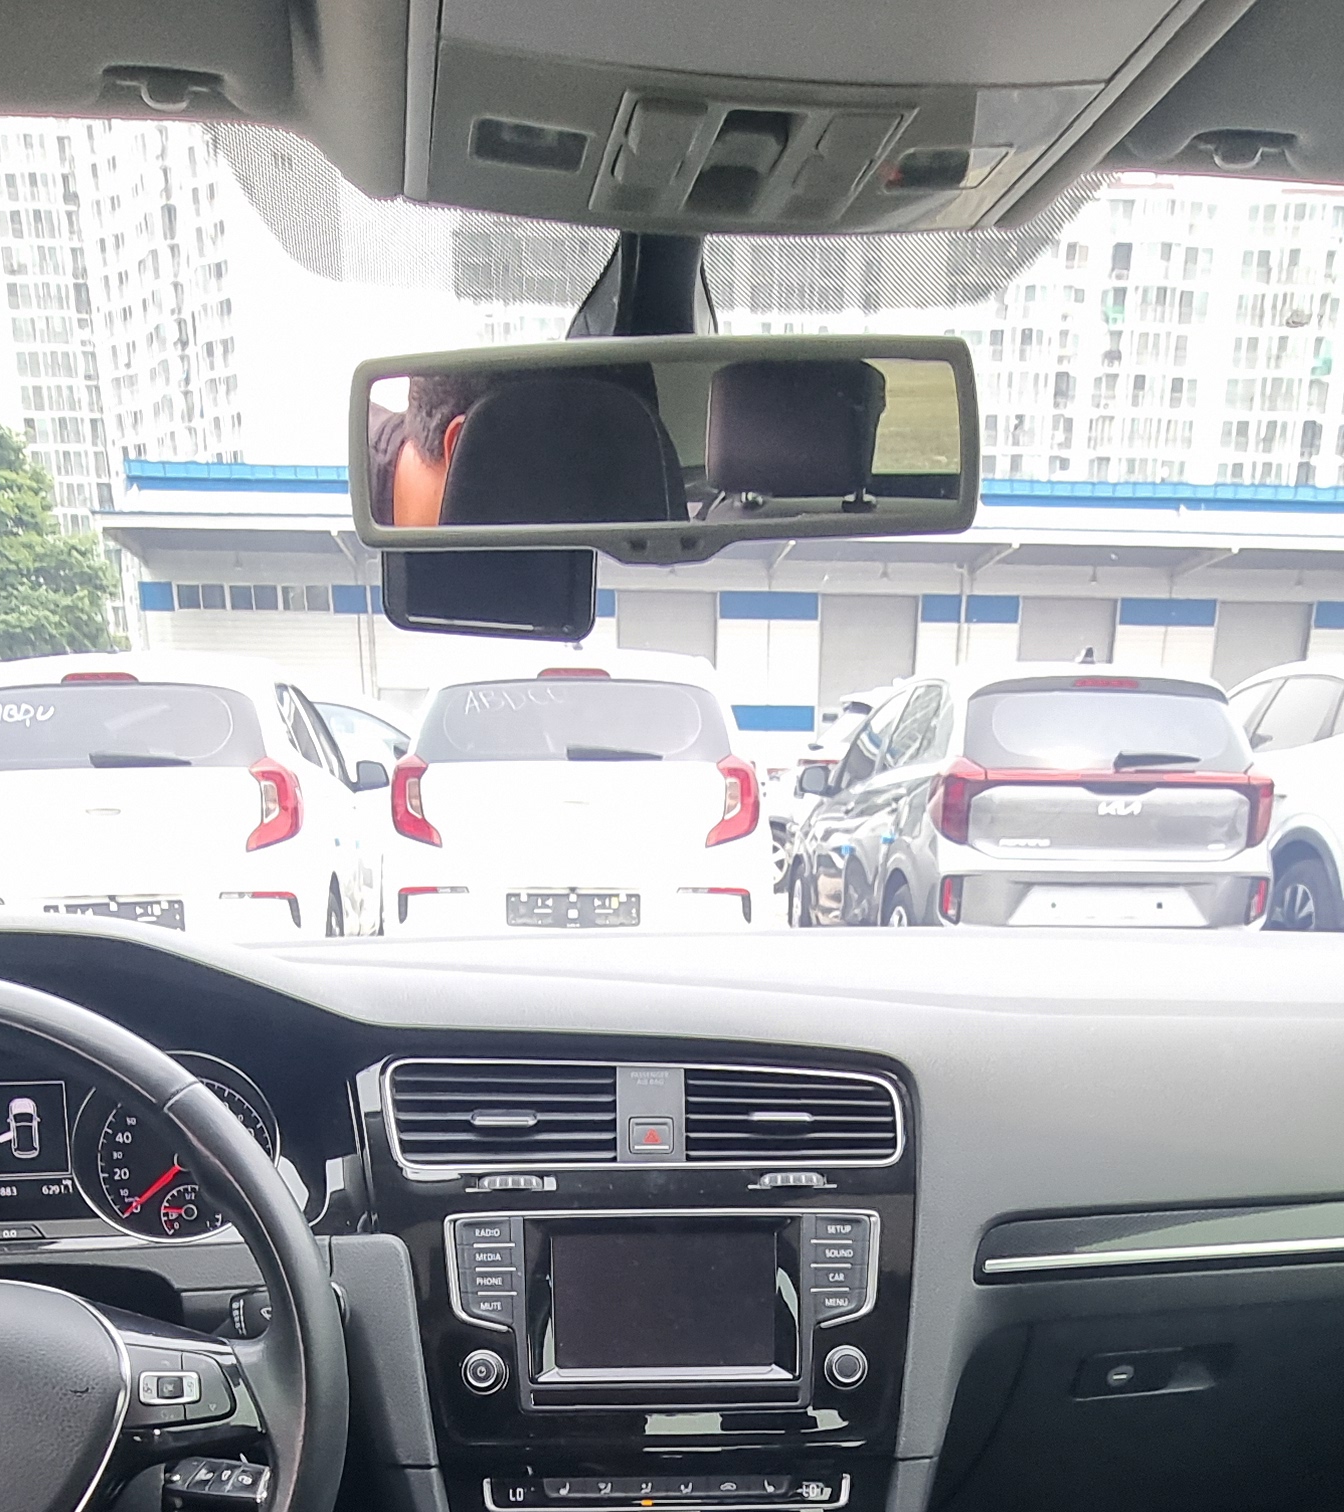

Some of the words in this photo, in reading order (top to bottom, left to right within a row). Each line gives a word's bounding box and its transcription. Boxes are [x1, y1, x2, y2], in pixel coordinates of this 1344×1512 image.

[115, 1131, 132, 1144] 40
[113, 1167, 129, 1180] 20
[475, 1228, 502, 1237] RADIO
[827, 1224, 852, 1234] SETUP
[475, 1252, 502, 1262] MEDIA
[825, 1248, 854, 1258] SOUND
[476, 1277, 503, 1286] PHONE
[828, 1272, 845, 1282] CAR
[480, 1301, 502, 1310] MUTE
[824, 1297, 849, 1307] MENU
